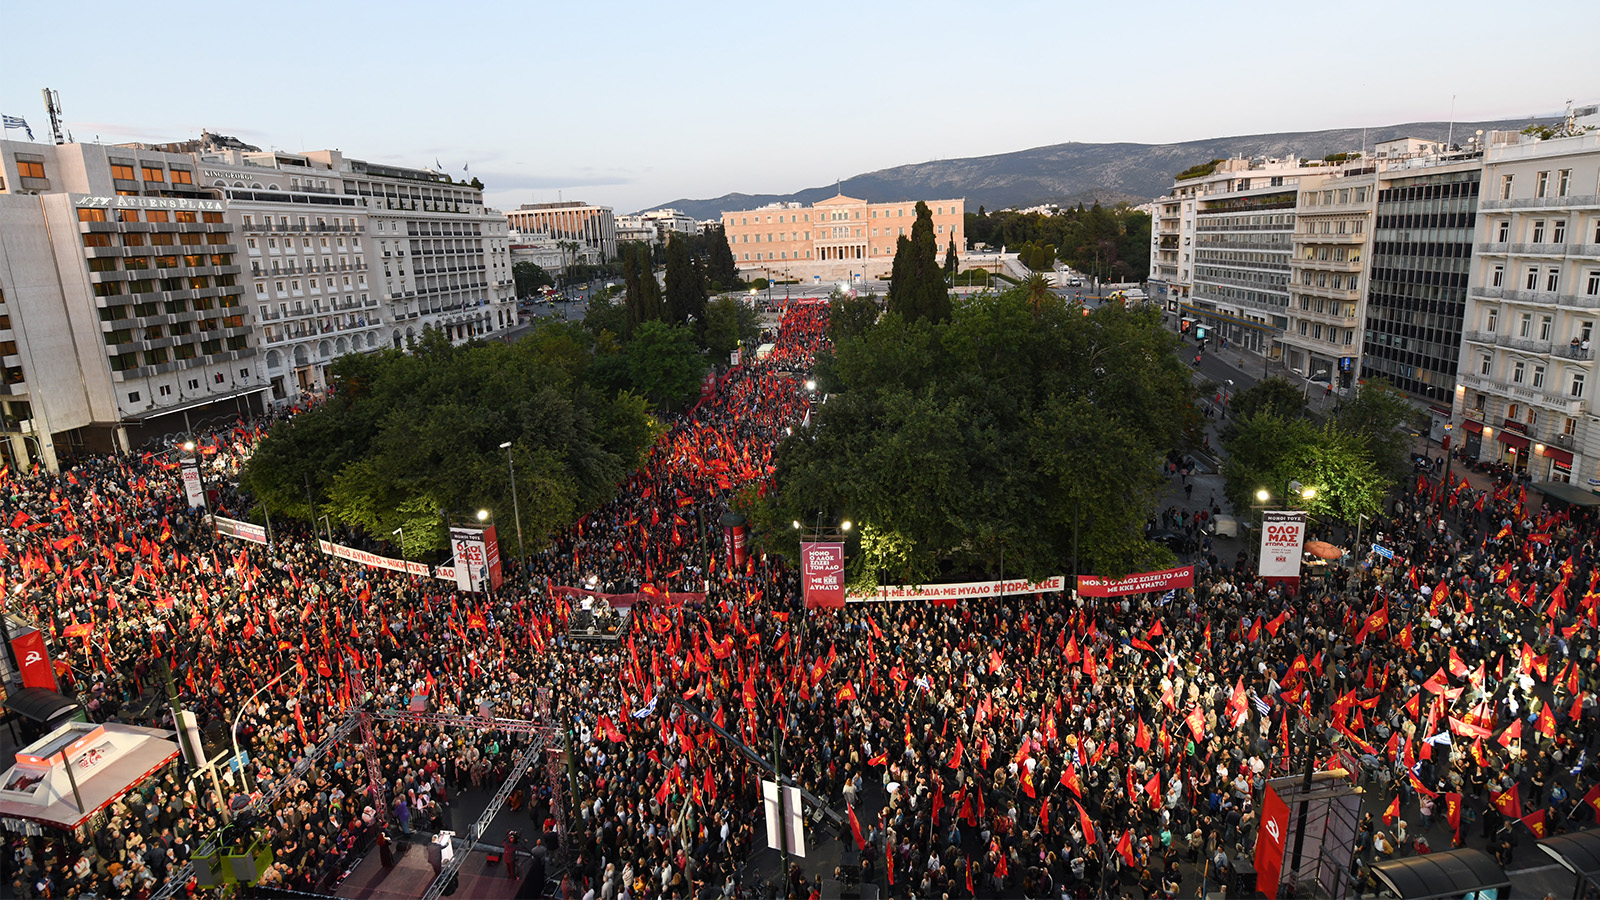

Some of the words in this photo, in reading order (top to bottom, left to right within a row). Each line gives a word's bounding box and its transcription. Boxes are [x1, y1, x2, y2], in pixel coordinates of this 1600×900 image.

[224, 172, 254, 180] GEORGE
[116, 196, 176, 208] ATHENS
[178, 198, 222, 210] PLAZA
[1267, 526, 1299, 534] ΟΛΟΙ
[1268, 534, 1297, 542] ΜΑΣ
[352, 552, 382, 564] ΔΥΝΑΤΟ
[1136, 580, 1167, 590] ΔΥΝΑΤΟ!
[958, 586, 990, 595] ΜΥΑΛΟ
